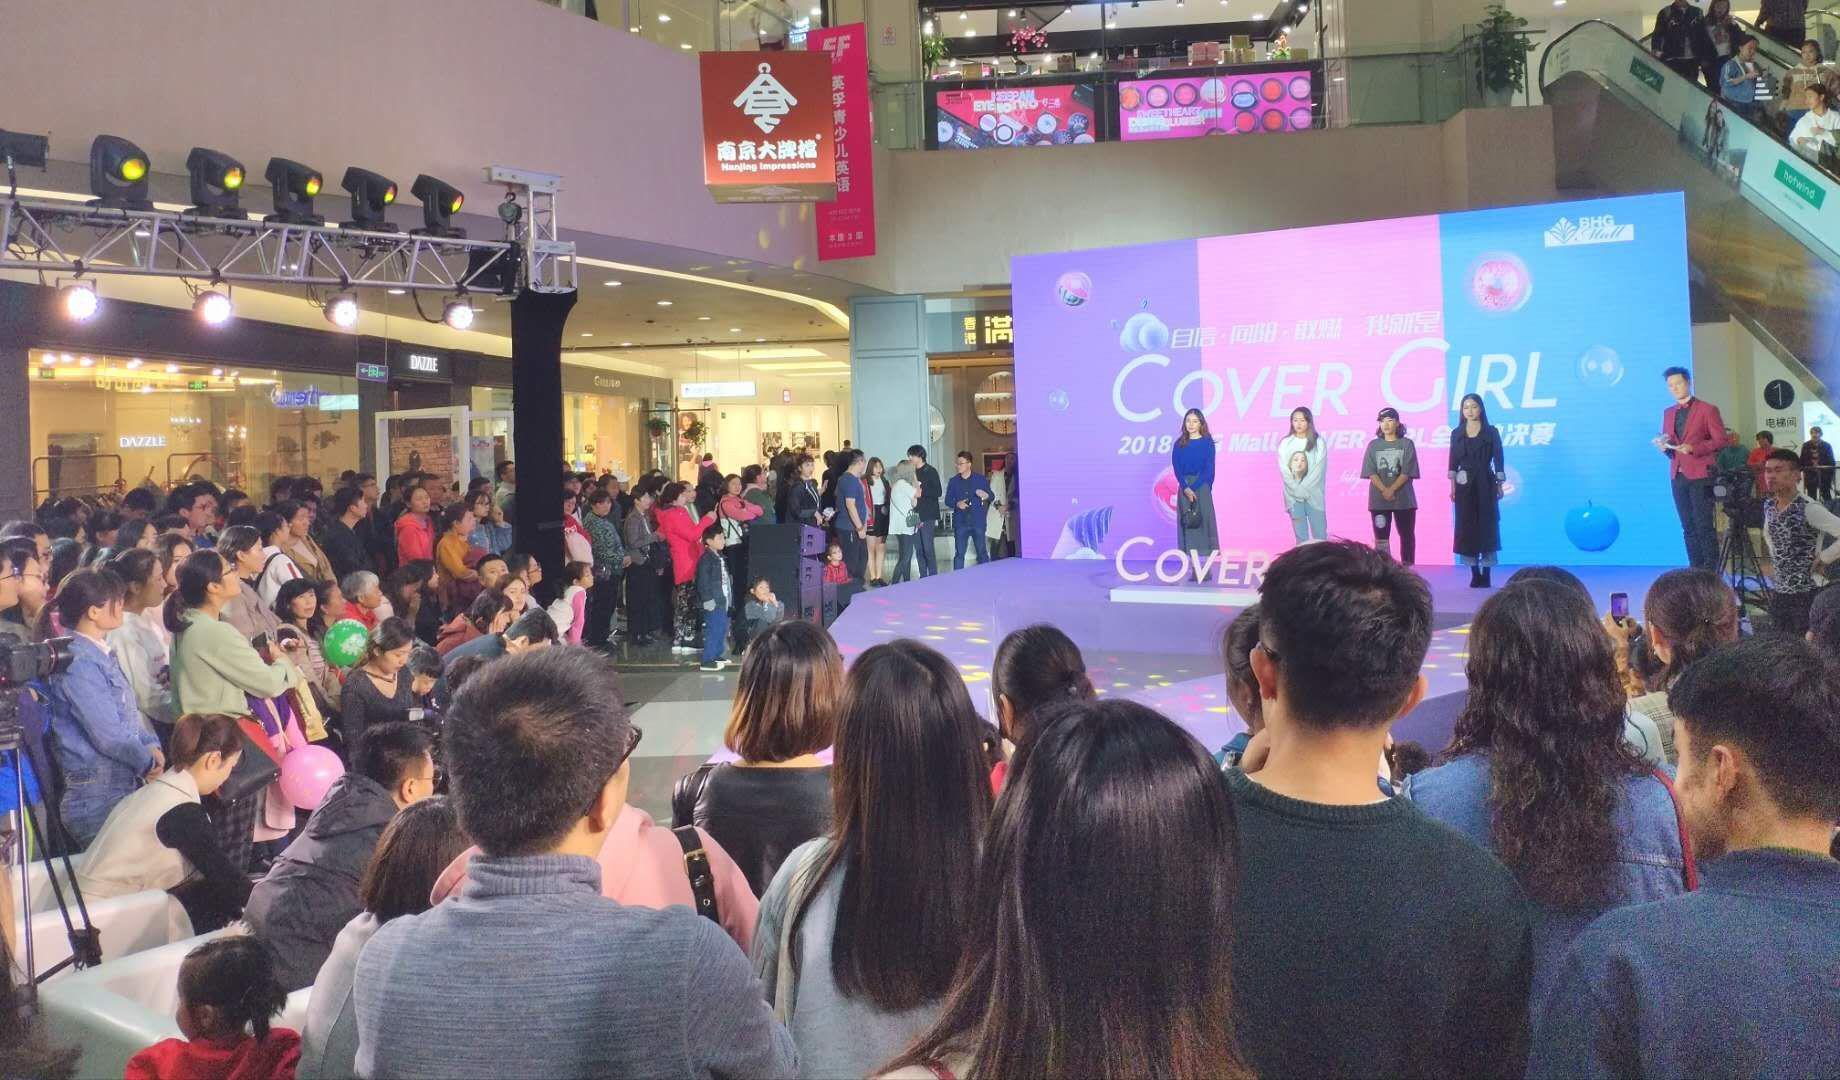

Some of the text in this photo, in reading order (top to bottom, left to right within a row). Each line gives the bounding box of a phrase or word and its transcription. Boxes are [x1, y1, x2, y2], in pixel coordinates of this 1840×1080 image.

[721, 161, 817, 172] Nanjing Impressions
[1783, 169, 1816, 200] hotwind
[1579, 214, 1615, 228] BHG
[410, 355, 438, 372] DAZZLE
[1112, 337, 1558, 422] COVER GIRL
[1771, 383, 1782, 407] 1
[1766, 416, 1797, 428] 电梯间
[120, 436, 166, 447] DAZZLE
[1117, 434, 1173, 455] 2018
[1229, 431, 1277, 453] Mall
[1115, 536, 1271, 585] COVER
